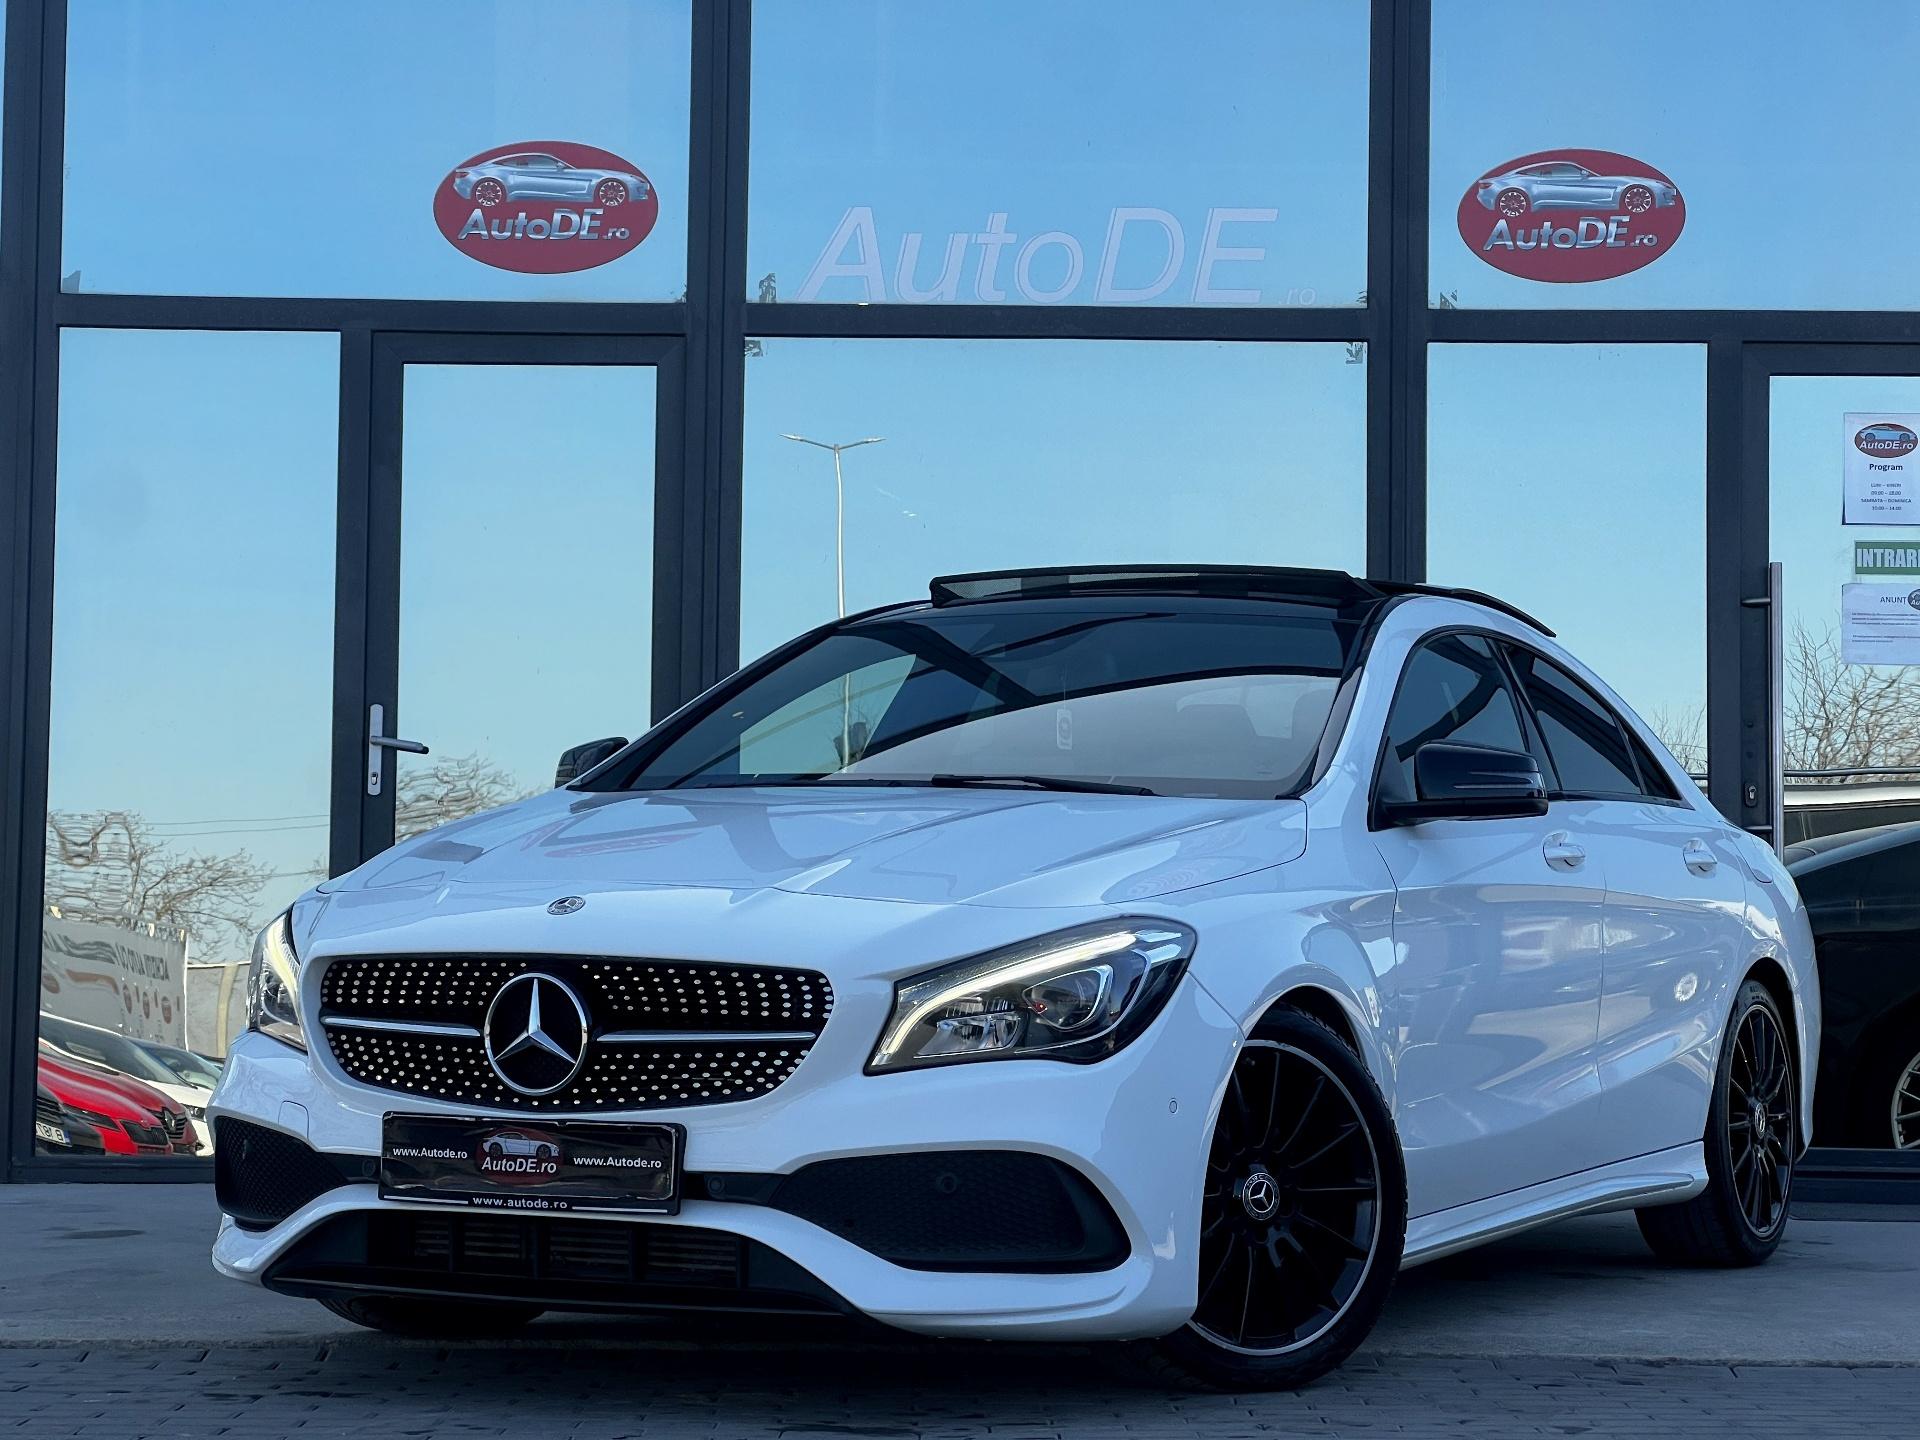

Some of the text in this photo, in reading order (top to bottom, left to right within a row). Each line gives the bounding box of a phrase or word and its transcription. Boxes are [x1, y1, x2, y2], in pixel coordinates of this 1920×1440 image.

[1859, 440, 1914, 450] AutoDE.ro
[1869, 463, 1903, 472] Program
[392, 1146, 468, 1160] www.Autode.ro
[481, 1156, 557, 1174] AutoDE.ro
[573, 1155, 662, 1169] www.Autode.ro
[472, 1195, 568, 1210] www.autode.ro
